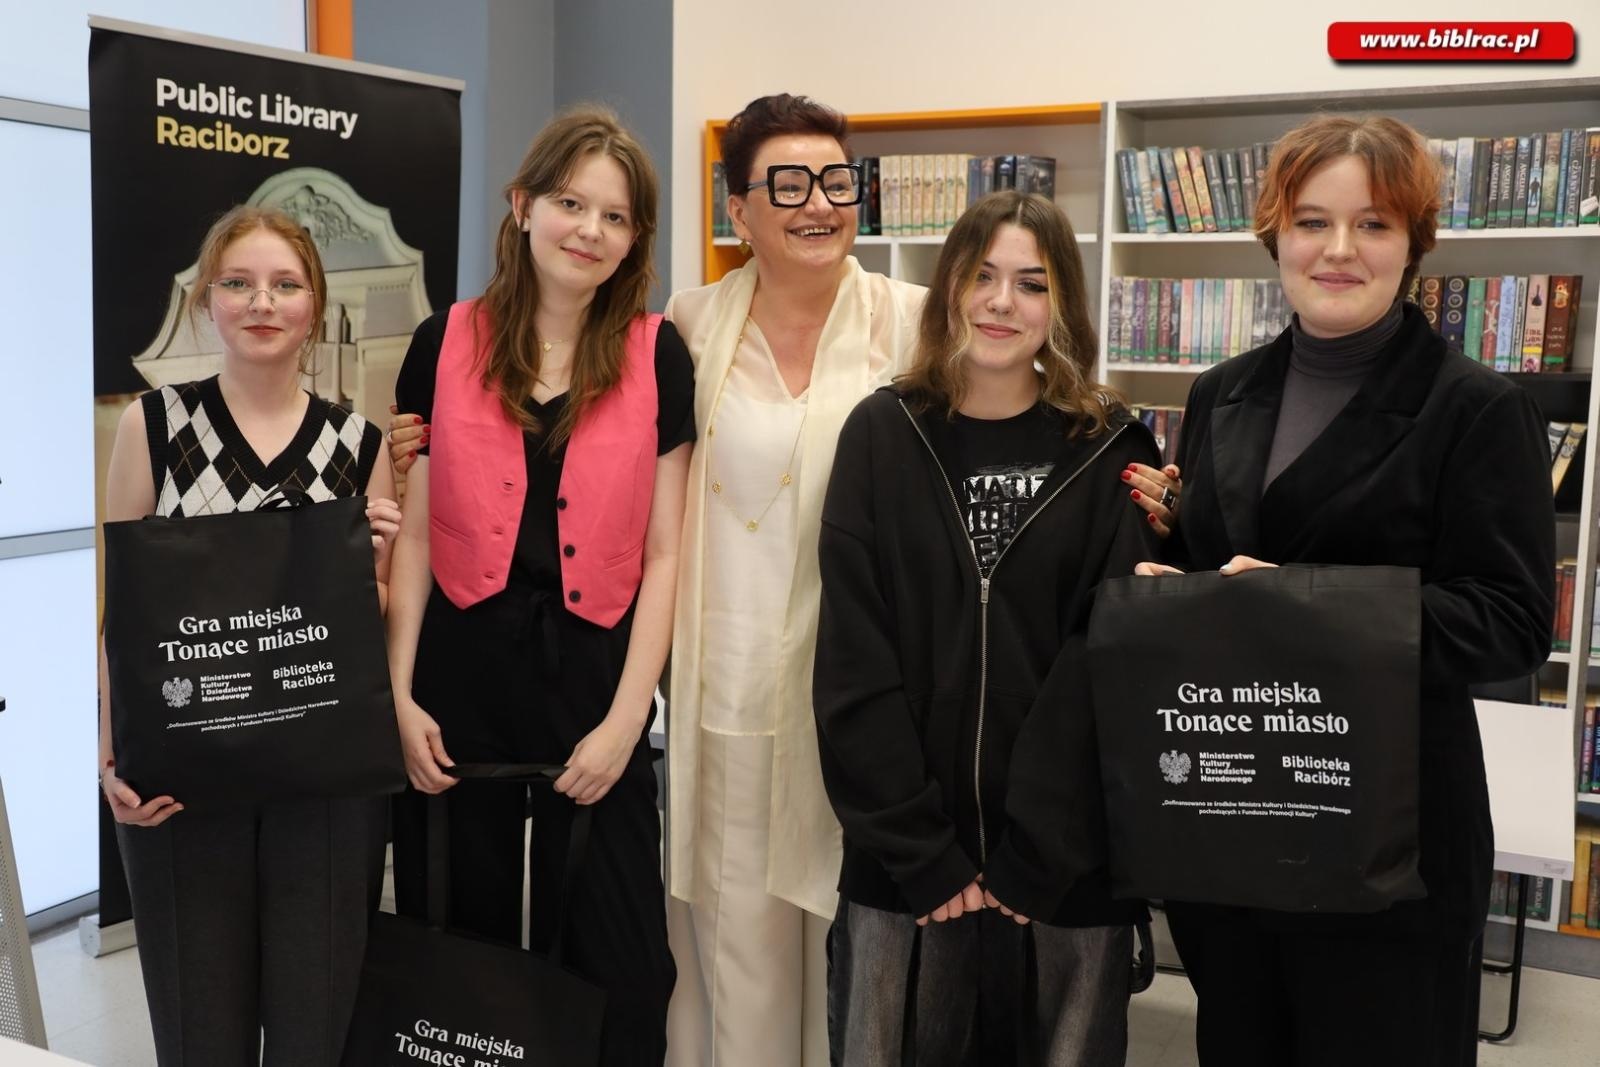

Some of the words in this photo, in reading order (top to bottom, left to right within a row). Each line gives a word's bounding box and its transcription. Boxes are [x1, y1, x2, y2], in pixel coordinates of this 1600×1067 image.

[156, 77, 253, 119] Public
[260, 93, 358, 139] Library
[157, 115, 290, 159] Raciborz
[179, 616, 221, 635] Gra
[229, 605, 302, 630] miejska
[158, 640, 249, 662] Tonące
[258, 624, 329, 652] miasto
[200, 672, 252, 682] Ministerstwo
[273, 660, 334, 680] Biblioteka
[200, 680, 230, 690] Kultury
[282, 673, 336, 690] Racibórz
[202, 692, 250, 703] Narodowego
[206, 685, 253, 696] Dziedzictwa
[1177, 682, 1224, 704] Gra
[1232, 681, 1322, 707] miejska
[1156, 708, 1253, 735] Tonące
[1263, 708, 1349, 735] miasto
[1199, 752, 1255, 760] Ministerstwo
[1199, 760, 1231, 768] Kultury
[1282, 755, 1351, 772] Biblioteka
[1200, 775, 1253, 784] Narodowego
[1205, 767, 1256, 776] Dziedzictwa
[1294, 770, 1351, 787] Racibórz
[414, 1019, 449, 1042] Gra
[455, 1032, 525, 1059] miejska
[395, 1032, 466, 1067] Tonące
